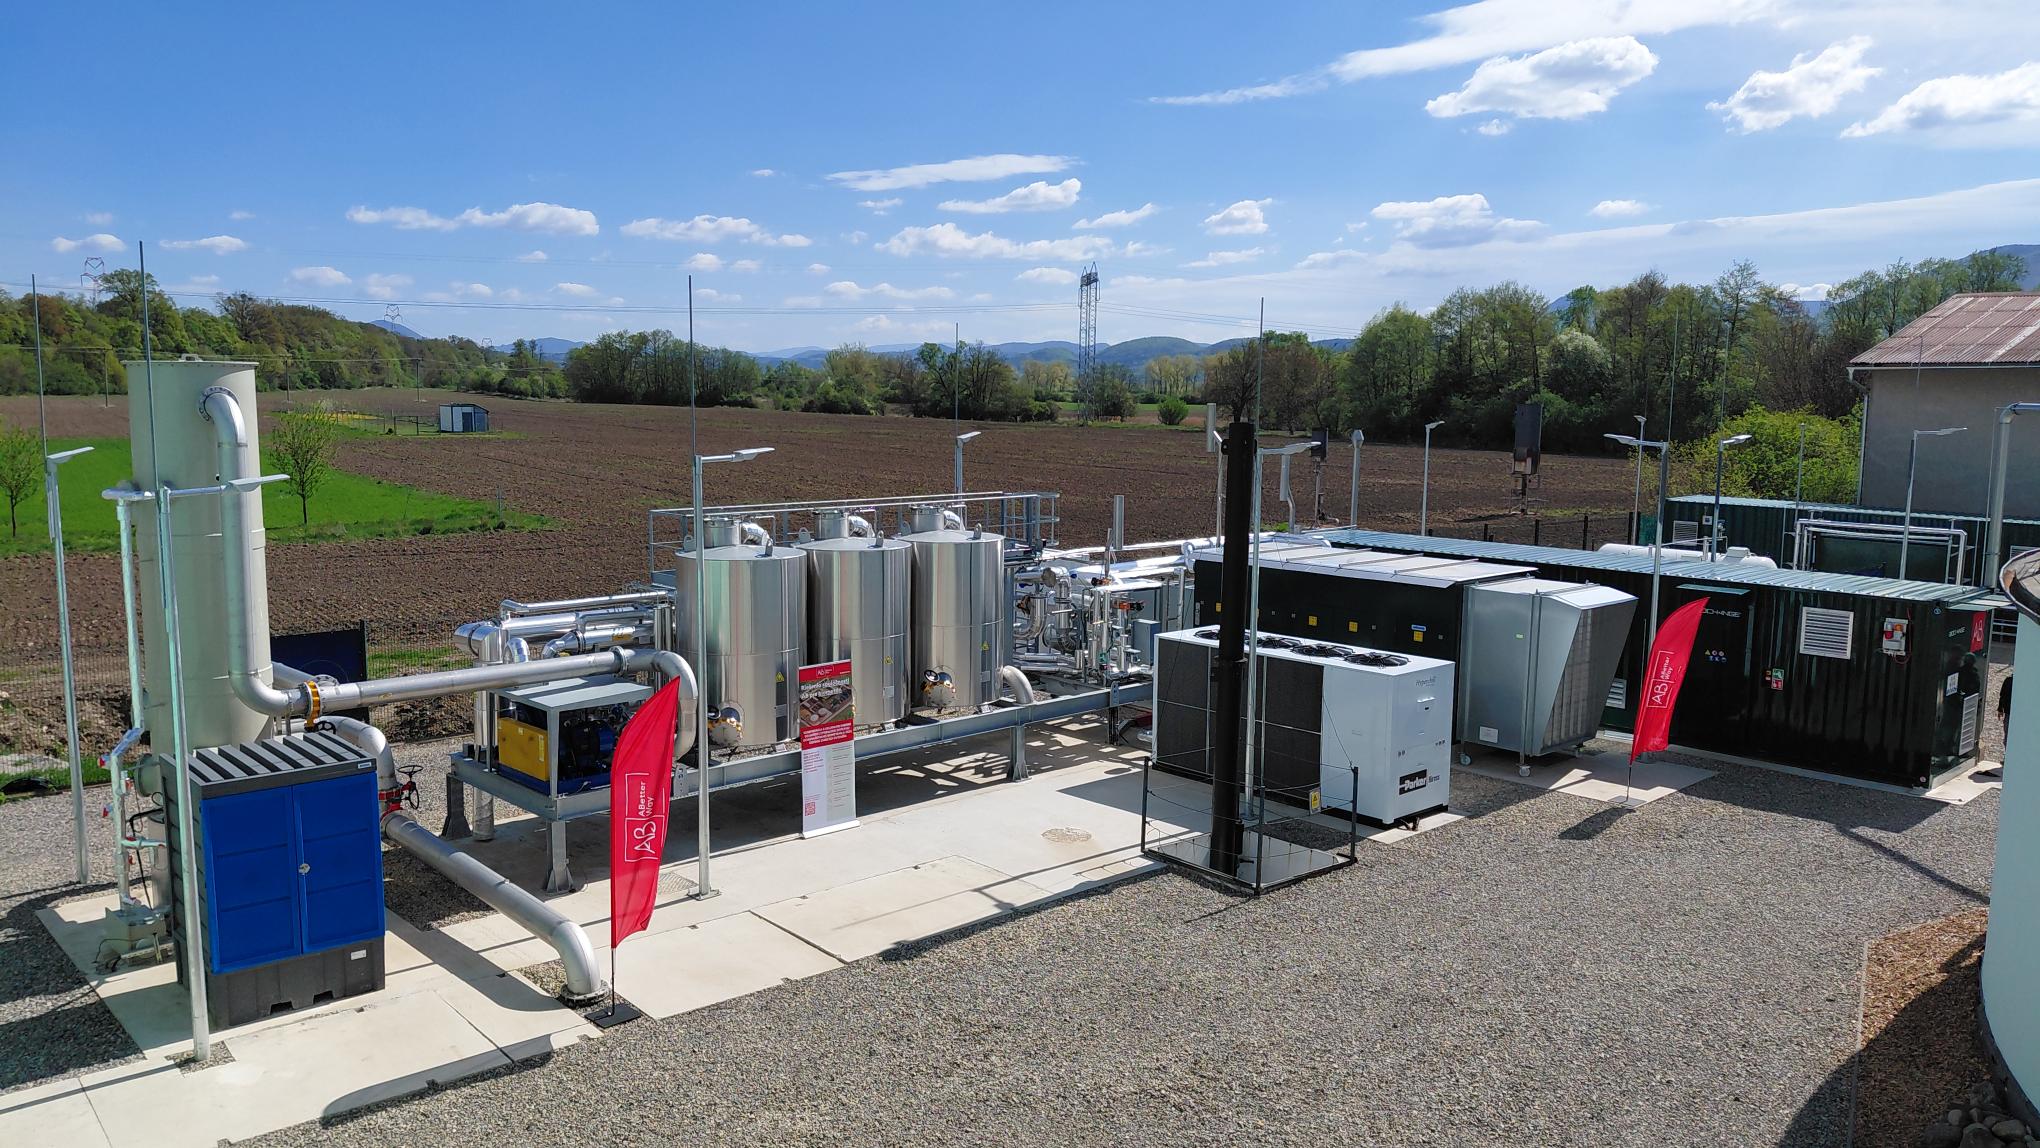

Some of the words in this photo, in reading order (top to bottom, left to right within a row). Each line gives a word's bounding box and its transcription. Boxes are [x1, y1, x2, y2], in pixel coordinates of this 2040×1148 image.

[1665, 667, 1674, 680] Way
[1652, 683, 1668, 705] AB
[1404, 777, 1427, 791] Parker
[638, 781, 646, 817] ABetter
[646, 797, 655, 817] Way
[634, 821, 657, 854] AB
